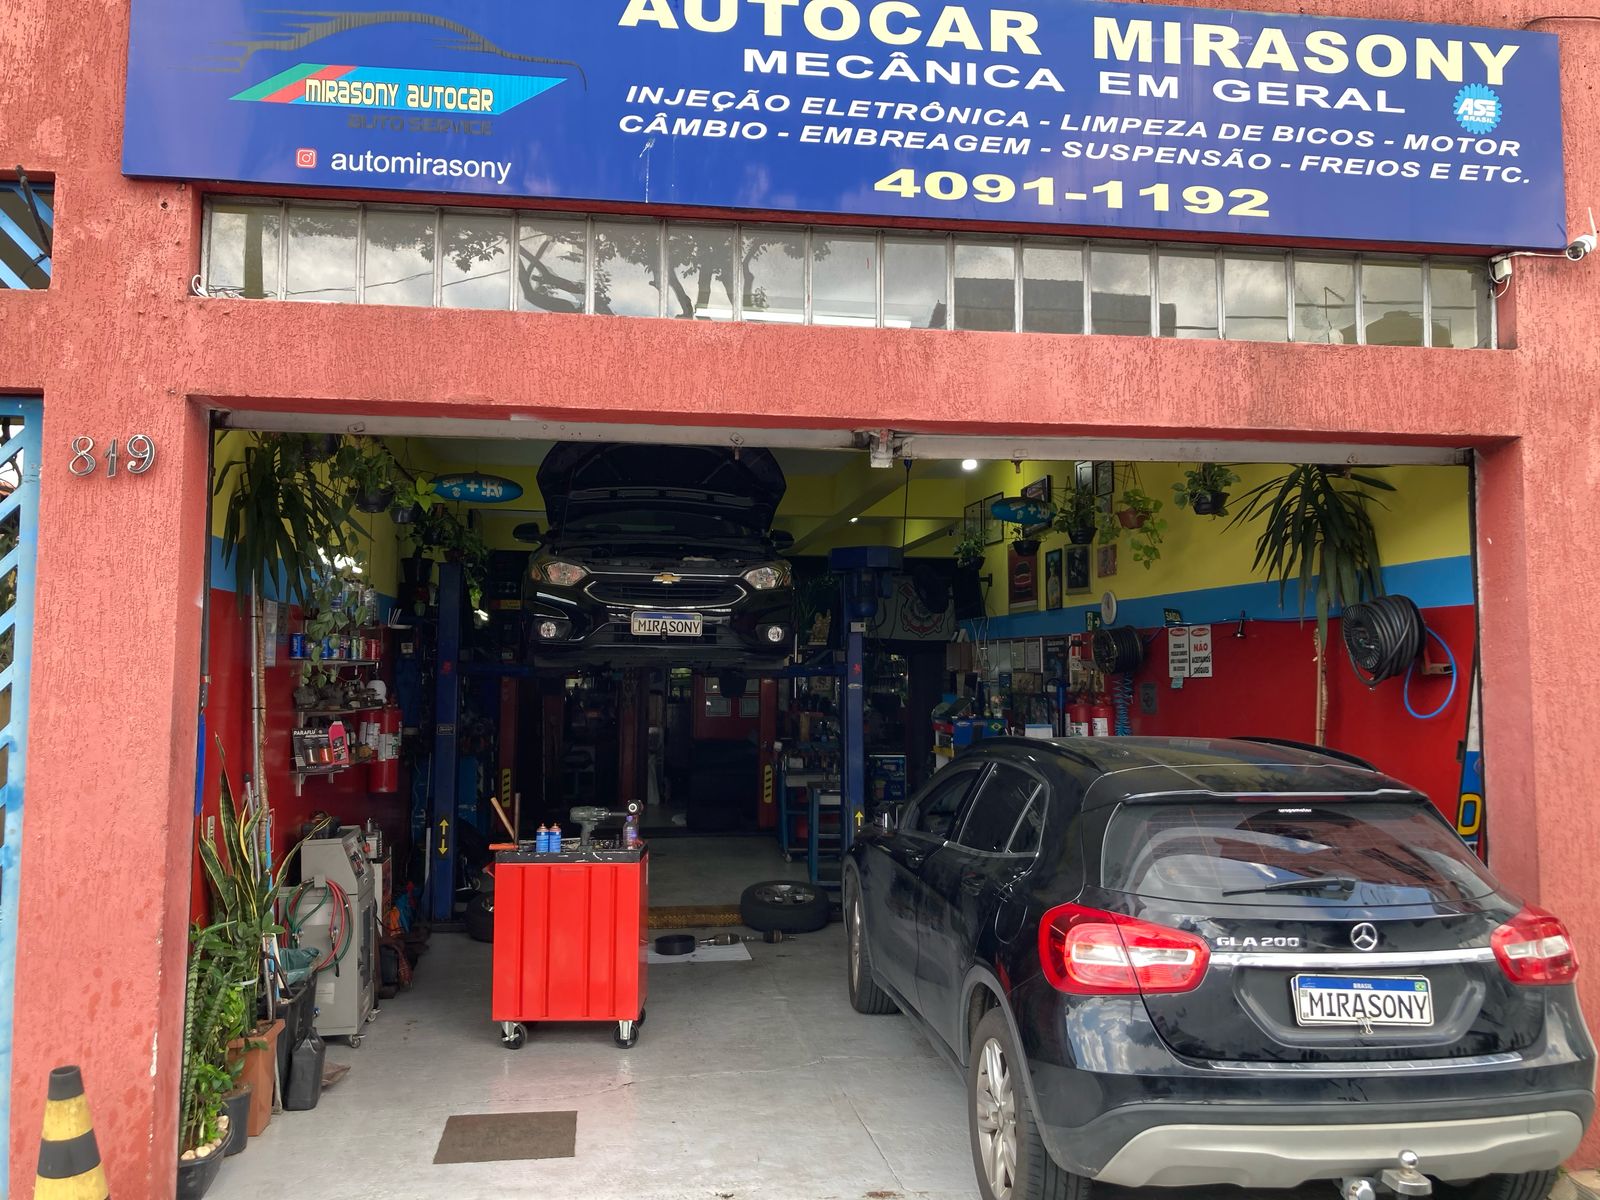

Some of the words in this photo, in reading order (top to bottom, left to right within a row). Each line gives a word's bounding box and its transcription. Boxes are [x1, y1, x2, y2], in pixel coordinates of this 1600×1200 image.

[617, 0, 1042, 56] AUTOCAR
[1093, 16, 1521, 87] MIRASONY
[743, 49, 1066, 93] MECÂNICA
[1099, 70, 1179, 100] EM
[1212, 78, 1406, 114] GERAL
[406, 84, 495, 112] AUTOCAR
[1458, 98, 1496, 117] ASE
[347, 113, 404, 132] AUTO
[409, 115, 493, 136] SERVICE
[625, 85, 791, 113] INJEÇÃO
[800, 96, 1029, 128] ELETRÔNICA
[1060, 113, 1208, 139] LIMPEZA
[1217, 122, 1265, 142] DE
[1271, 125, 1375, 148] BICOS
[1403, 133, 1521, 157] MOTOR
[1463, 115, 1495, 124] BRASIL
[619, 112, 768, 140] CÂMBIO
[799, 125, 1031, 155] EMBREAGEM
[1061, 140, 1272, 170] SUSPENSÃO
[1299, 155, 1421, 178] FREIOS
[1429, 162, 1452, 180] E
[1458, 164, 1530, 184] ETC.
[330, 150, 512, 185] automirasony
[874, 168, 1270, 218] 4091-1192
[68, 434, 156, 478] 819
[638, 619, 700, 633] MIRASONY
[1193, 640, 1209, 652] NÃO
[1216, 936, 1257, 947] GLA
[1260, 936, 1300, 947] 200
[1308, 991, 1427, 1020] MIRASONY
